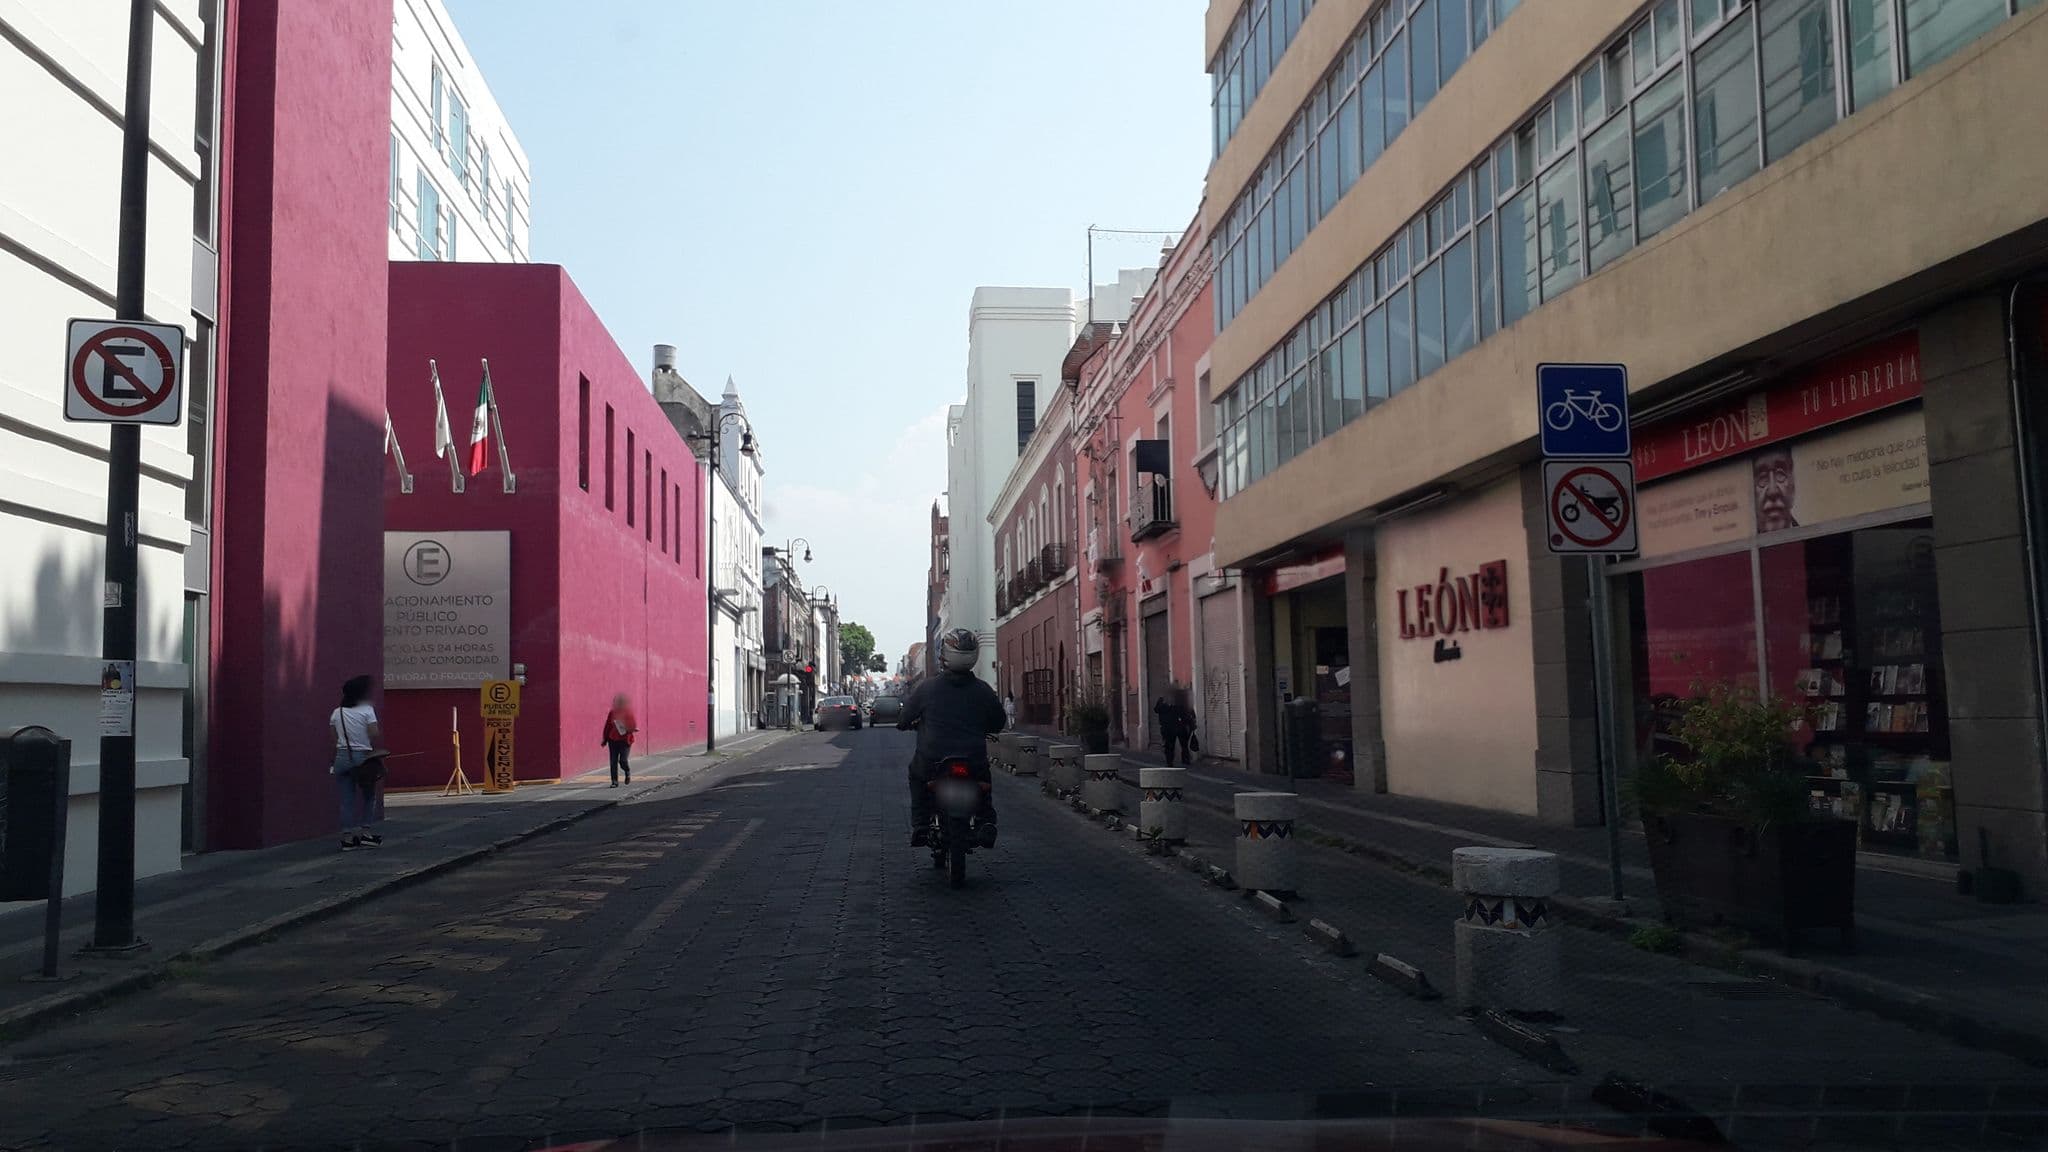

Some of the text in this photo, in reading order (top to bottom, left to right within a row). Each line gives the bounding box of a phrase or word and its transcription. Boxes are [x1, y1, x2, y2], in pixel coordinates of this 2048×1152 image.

[102, 345, 145, 399] E
[1802, 353, 1918, 415] TU LIBRERÍA
[417, 548, 440, 578] E
[1395, 566, 1481, 640] LEÓN
[397, 609, 458, 622] PÚBLICO
[426, 624, 489, 636] PRIVADO
[413, 644, 434, 653] LAS
[437, 643, 452, 653] 24
[454, 643, 495, 653] HORAS
[430, 654, 500, 665] COMODIDAD
[494, 687, 505, 700] E
[497, 728, 511, 790] BIENVENIDOS
